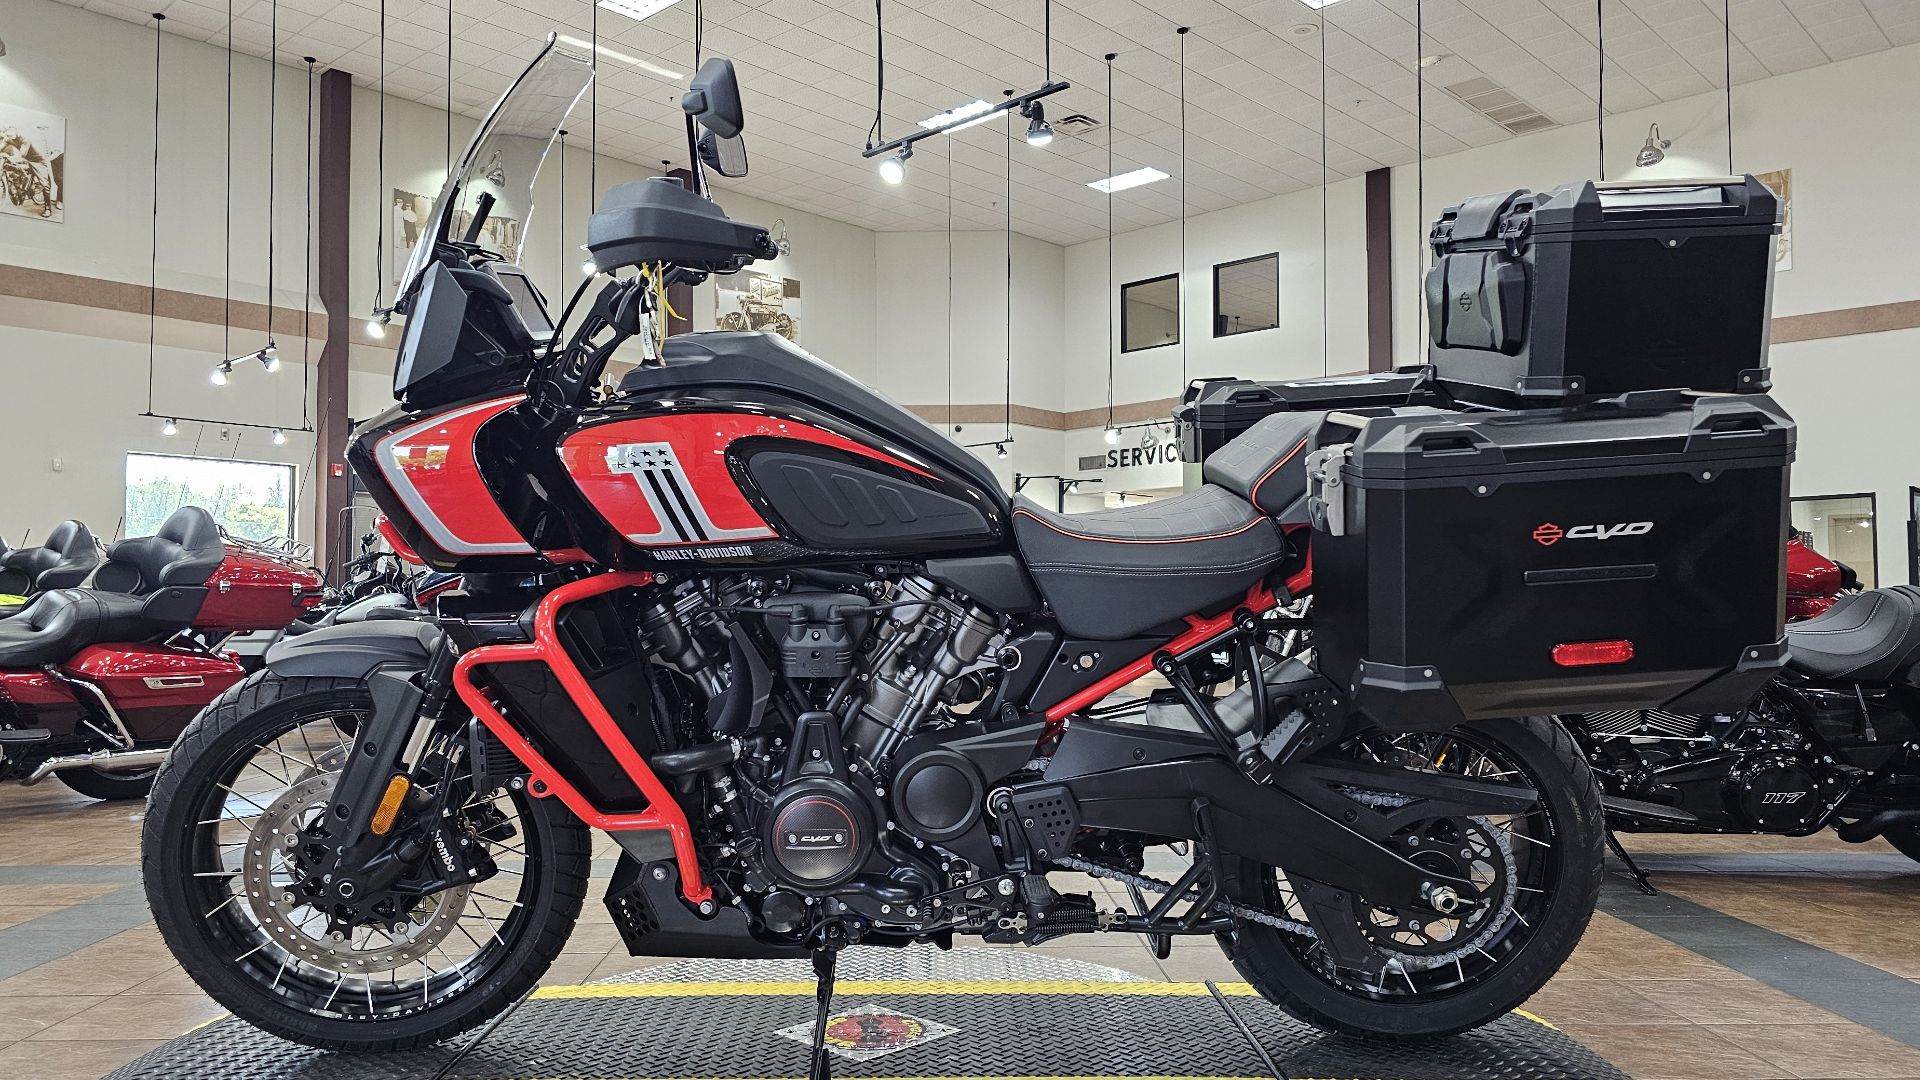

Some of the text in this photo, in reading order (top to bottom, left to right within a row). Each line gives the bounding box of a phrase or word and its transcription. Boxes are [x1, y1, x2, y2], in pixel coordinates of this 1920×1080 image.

[1107, 442, 1178, 468] SERVIC
[1565, 521, 1654, 540] CVO
[653, 545, 753, 561] HARLEY-DAVIDSON
[1761, 791, 1807, 804] 117
[800, 835, 833, 843] CVO
[309, 978, 476, 1021] HRLEY-DAVIDSON
